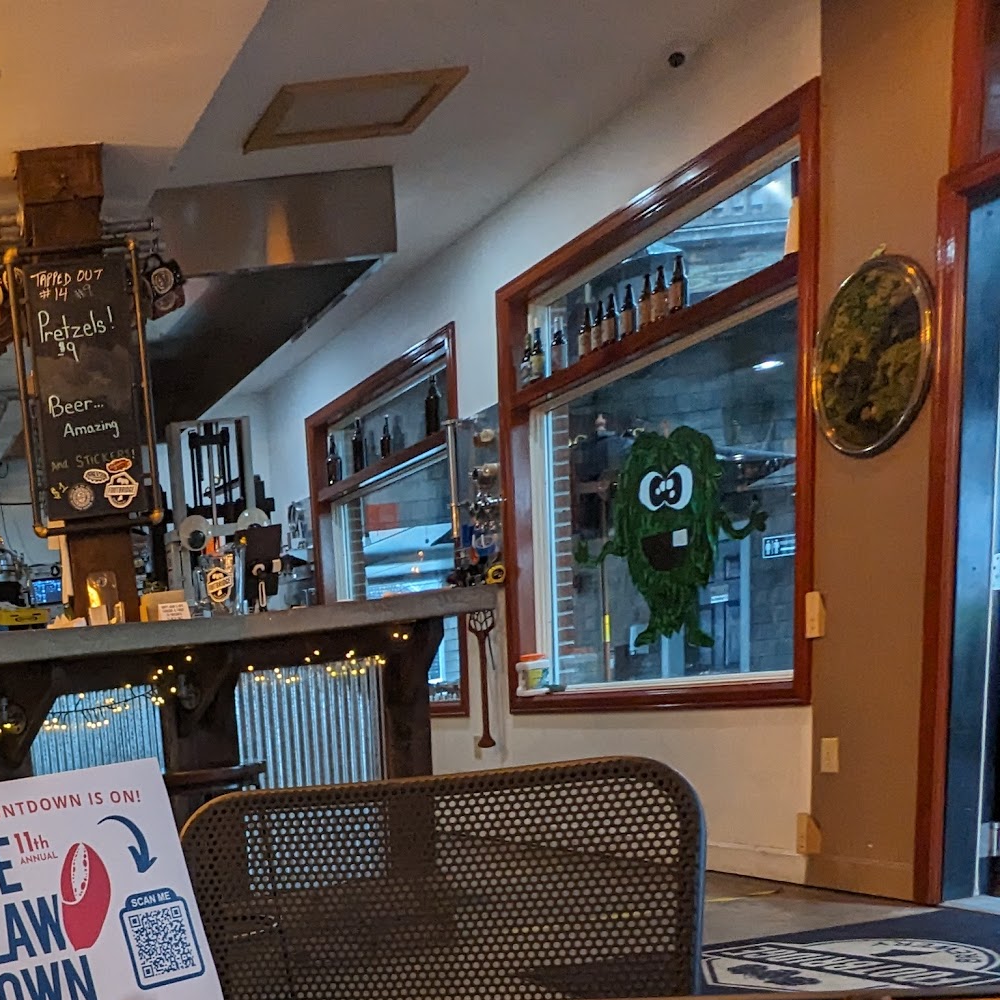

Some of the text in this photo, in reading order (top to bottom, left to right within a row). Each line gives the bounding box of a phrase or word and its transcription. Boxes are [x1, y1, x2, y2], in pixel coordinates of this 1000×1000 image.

[30, 269, 103, 287] TAPPED OUT
[38, 306, 114, 343] Pretzels!
[58, 342, 79, 362] $9
[64, 421, 119, 438] Amazing
[88, 792, 103, 805] IS
[110, 790, 141, 803] ON!
[14, 832, 49, 853] 11th
[21, 852, 58, 864] ANNUAL
[131, 891, 171, 907] SCAN ME
